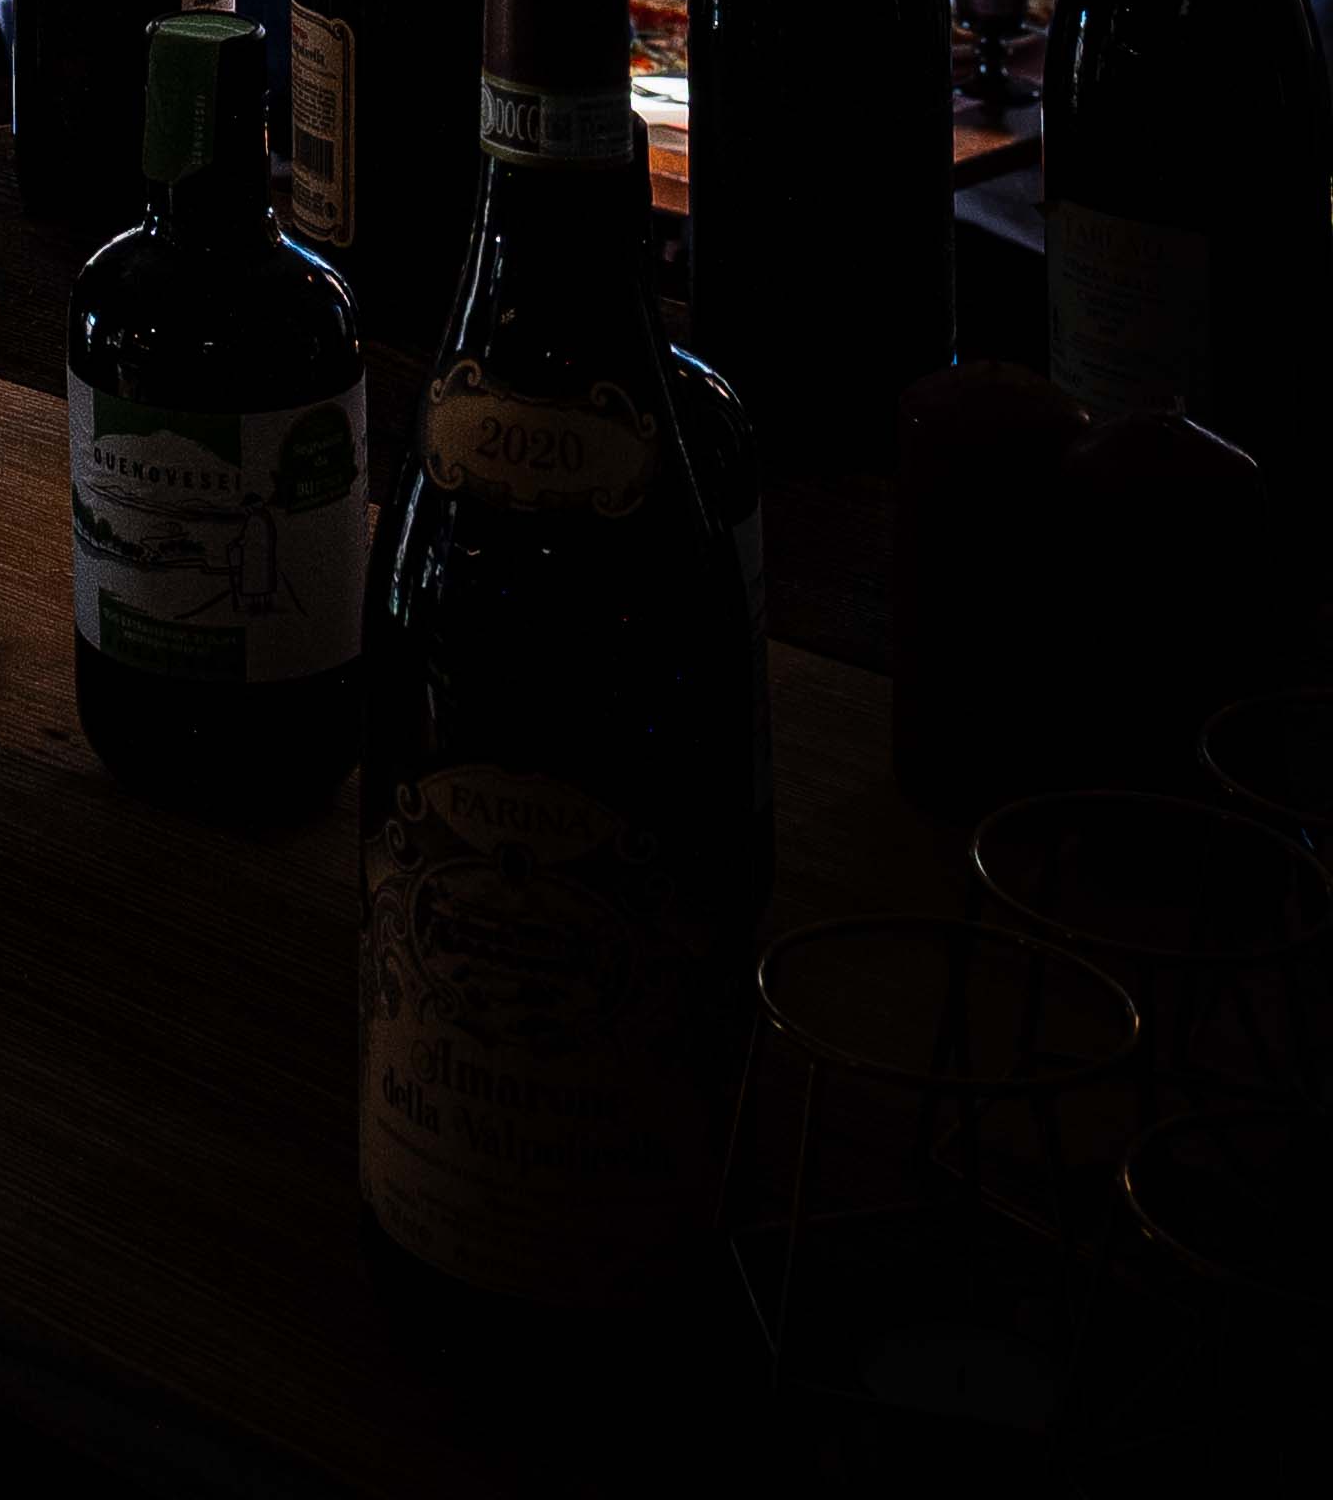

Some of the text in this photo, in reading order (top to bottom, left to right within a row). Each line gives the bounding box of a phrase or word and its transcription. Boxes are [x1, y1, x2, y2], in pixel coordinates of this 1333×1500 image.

[476, 416, 584, 473] 2020
[451, 784, 596, 839] FARINA
[382, 1064, 440, 1135] della
